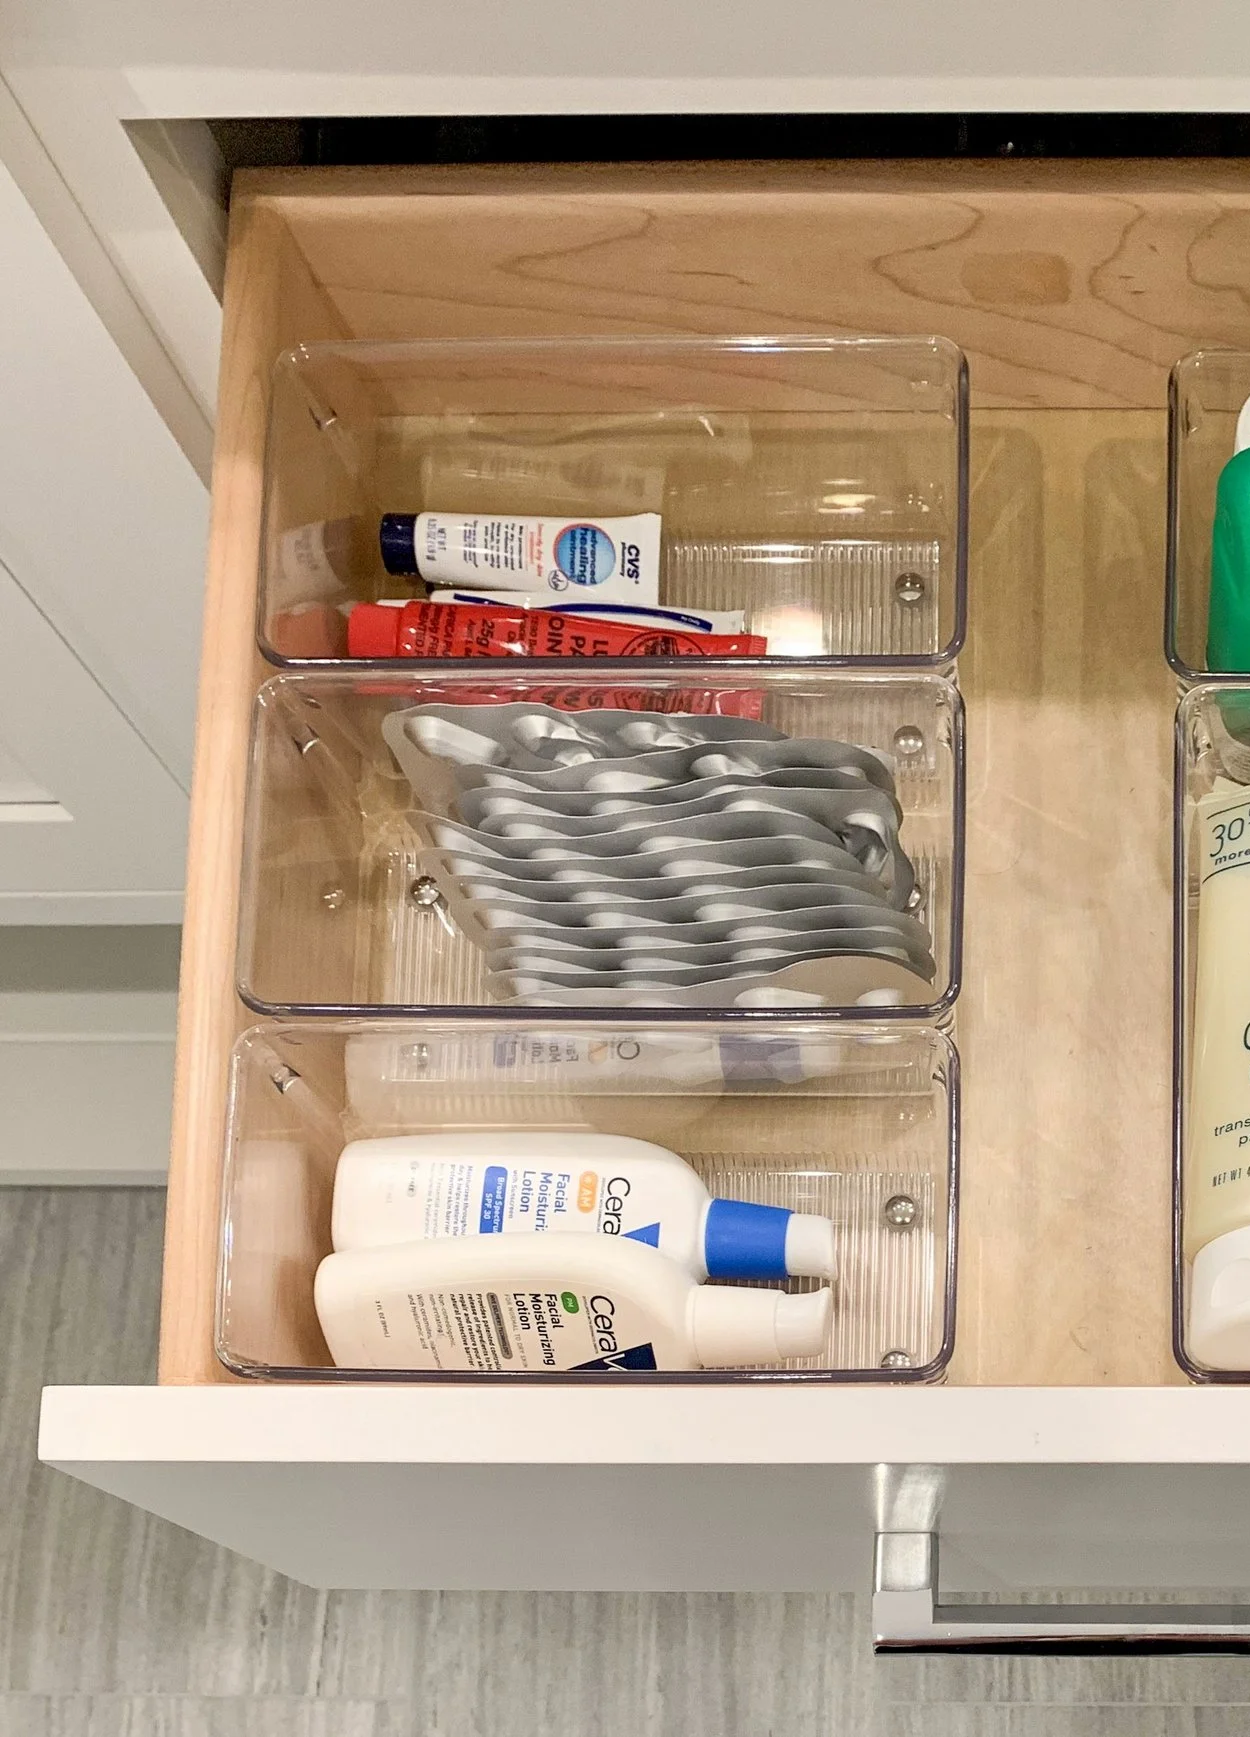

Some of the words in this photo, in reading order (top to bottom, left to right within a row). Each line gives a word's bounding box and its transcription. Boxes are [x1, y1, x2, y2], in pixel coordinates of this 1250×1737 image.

[577, 527, 589, 584] healing
[627, 544, 640, 580] CVS
[476, 618, 495, 648] 25g
[496, 1177, 505, 1200] Broad
[520, 1170, 536, 1213] Lotion
[1212, 1172, 1227, 1188] NET
[1230, 1167, 1242, 1182] WT
[554, 1173, 570, 1213] Facial
[602, 1177, 631, 1236] Cera
[483, 1210, 491, 1220] 30
[450, 1293, 461, 1316] natural
[458, 1293, 468, 1312] repair
[513, 1293, 531, 1330] Lotion
[545, 1293, 564, 1328] Facial
[565, 1297, 575, 1308] PM
[455, 1316, 468, 1346] protective
[467, 1293, 477, 1316] release
[475, 1323, 488, 1357] ingredients
[476, 1293, 487, 1319] Provides
[482, 1320, 495, 1346] patented
[507, 1306, 517, 1331] NORMAL
[529, 1293, 556, 1366] Moisturizing
[590, 1295, 627, 1370] CeraV
[467, 1325, 477, 1346] restore
[464, 1346, 475, 1367] barrier
[471, 1347, 481, 1361] your
